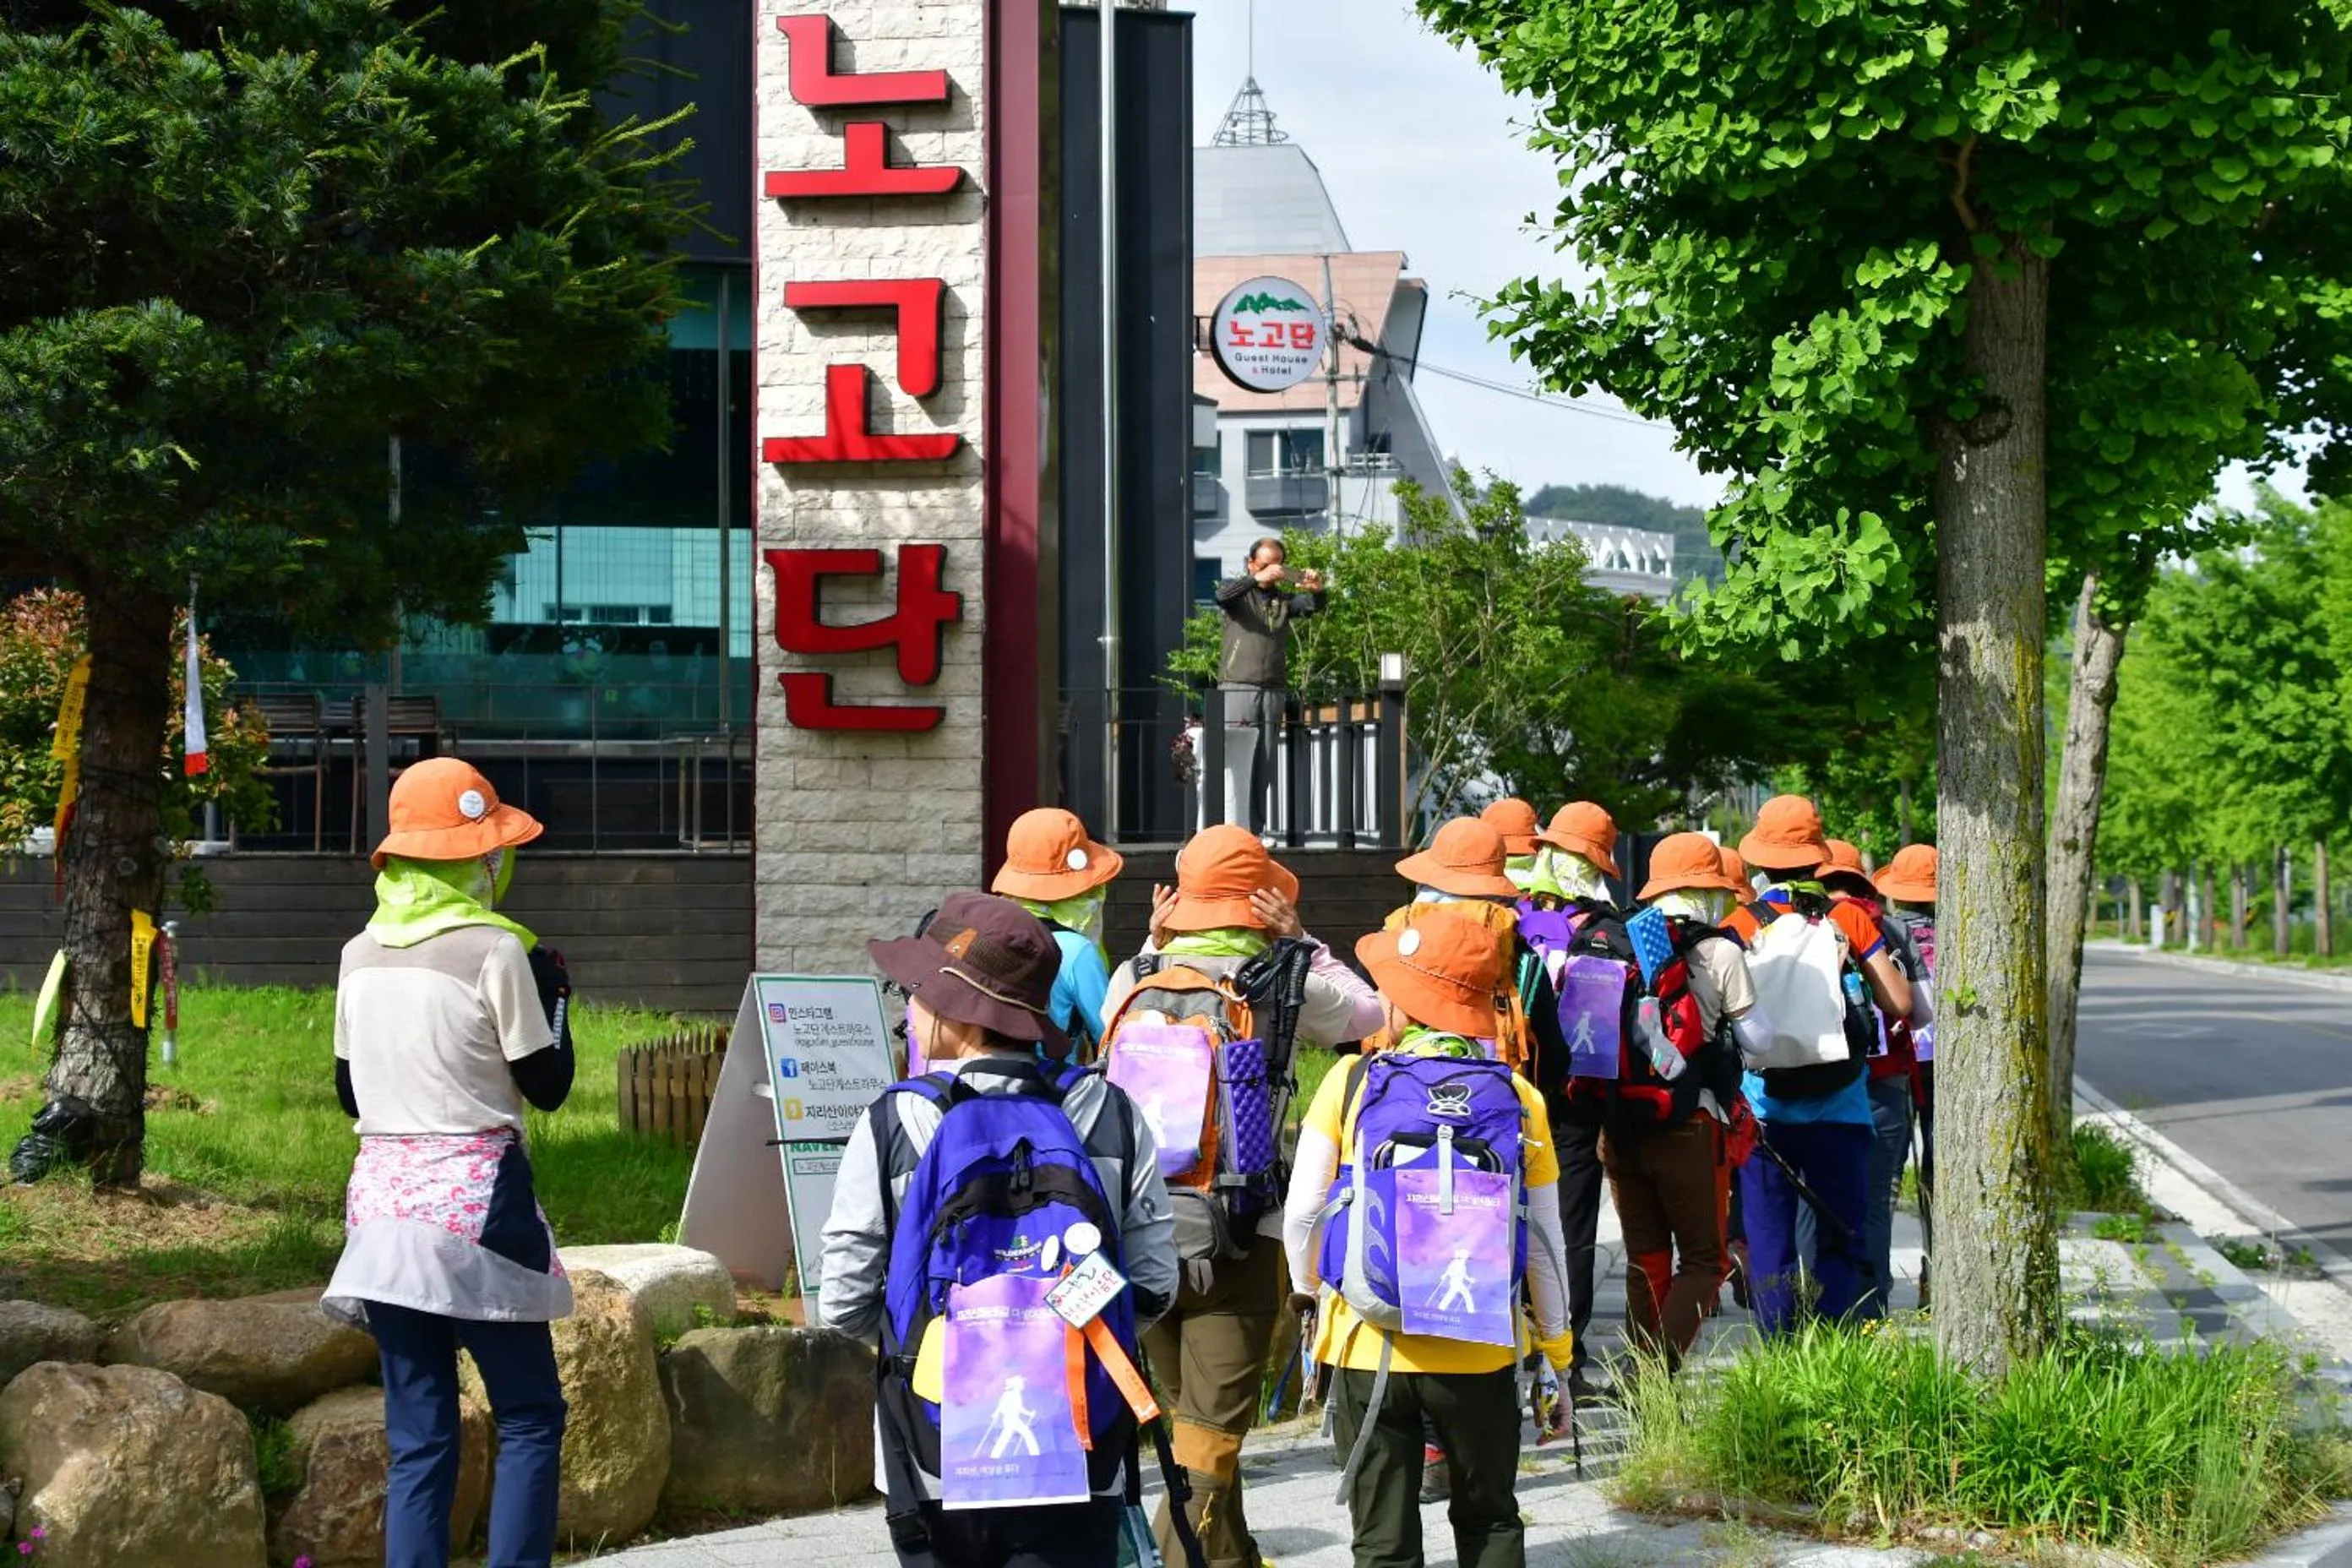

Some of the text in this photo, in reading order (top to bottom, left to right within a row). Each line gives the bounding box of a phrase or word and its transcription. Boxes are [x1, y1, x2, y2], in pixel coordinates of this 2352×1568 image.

[1228, 320, 1315, 350] 노고단
[1234, 352, 1309, 364] Guest House
[763, 14, 966, 731] 노고단
[1260, 365, 1292, 375] Hotel
